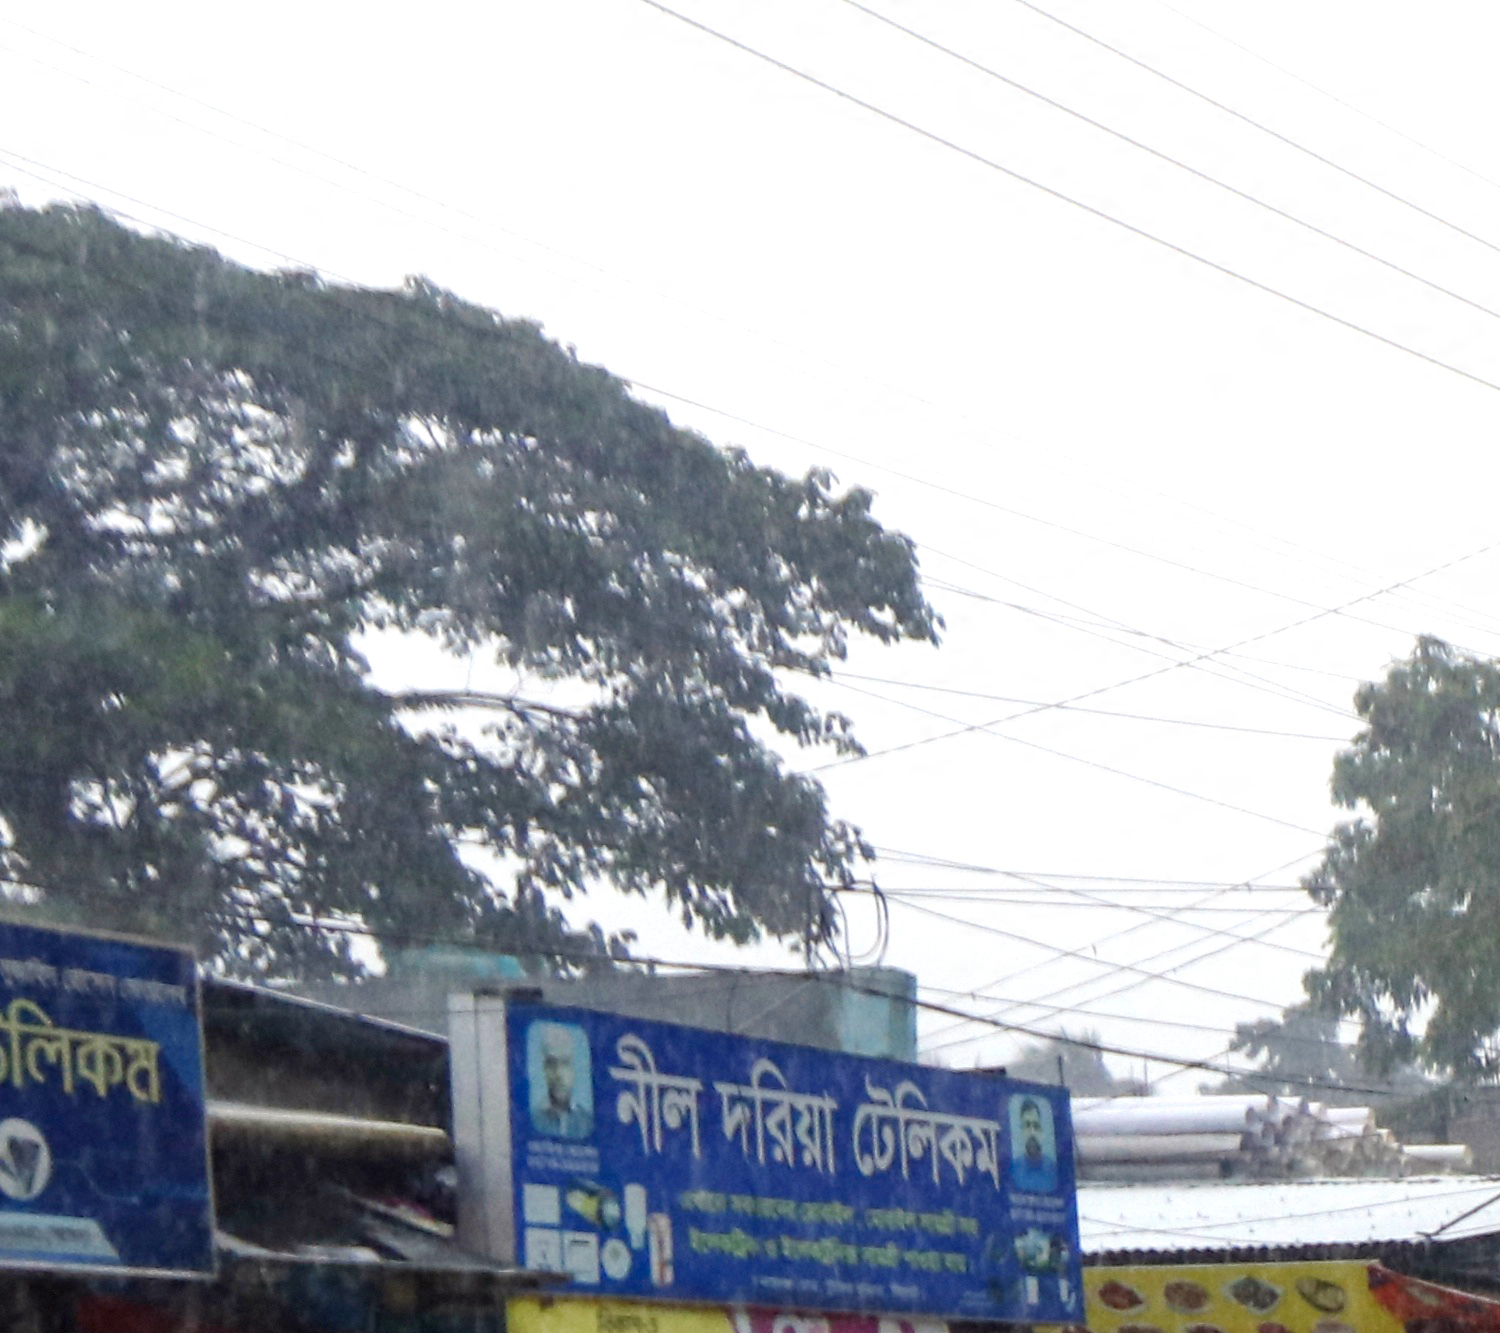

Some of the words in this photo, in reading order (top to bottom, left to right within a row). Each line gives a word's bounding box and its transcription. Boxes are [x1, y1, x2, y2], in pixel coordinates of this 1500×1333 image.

[608, 1033, 703, 1160] নীল
[714, 1057, 838, 1177] দরিয়া
[852, 1074, 1003, 1191] টেলিকম
